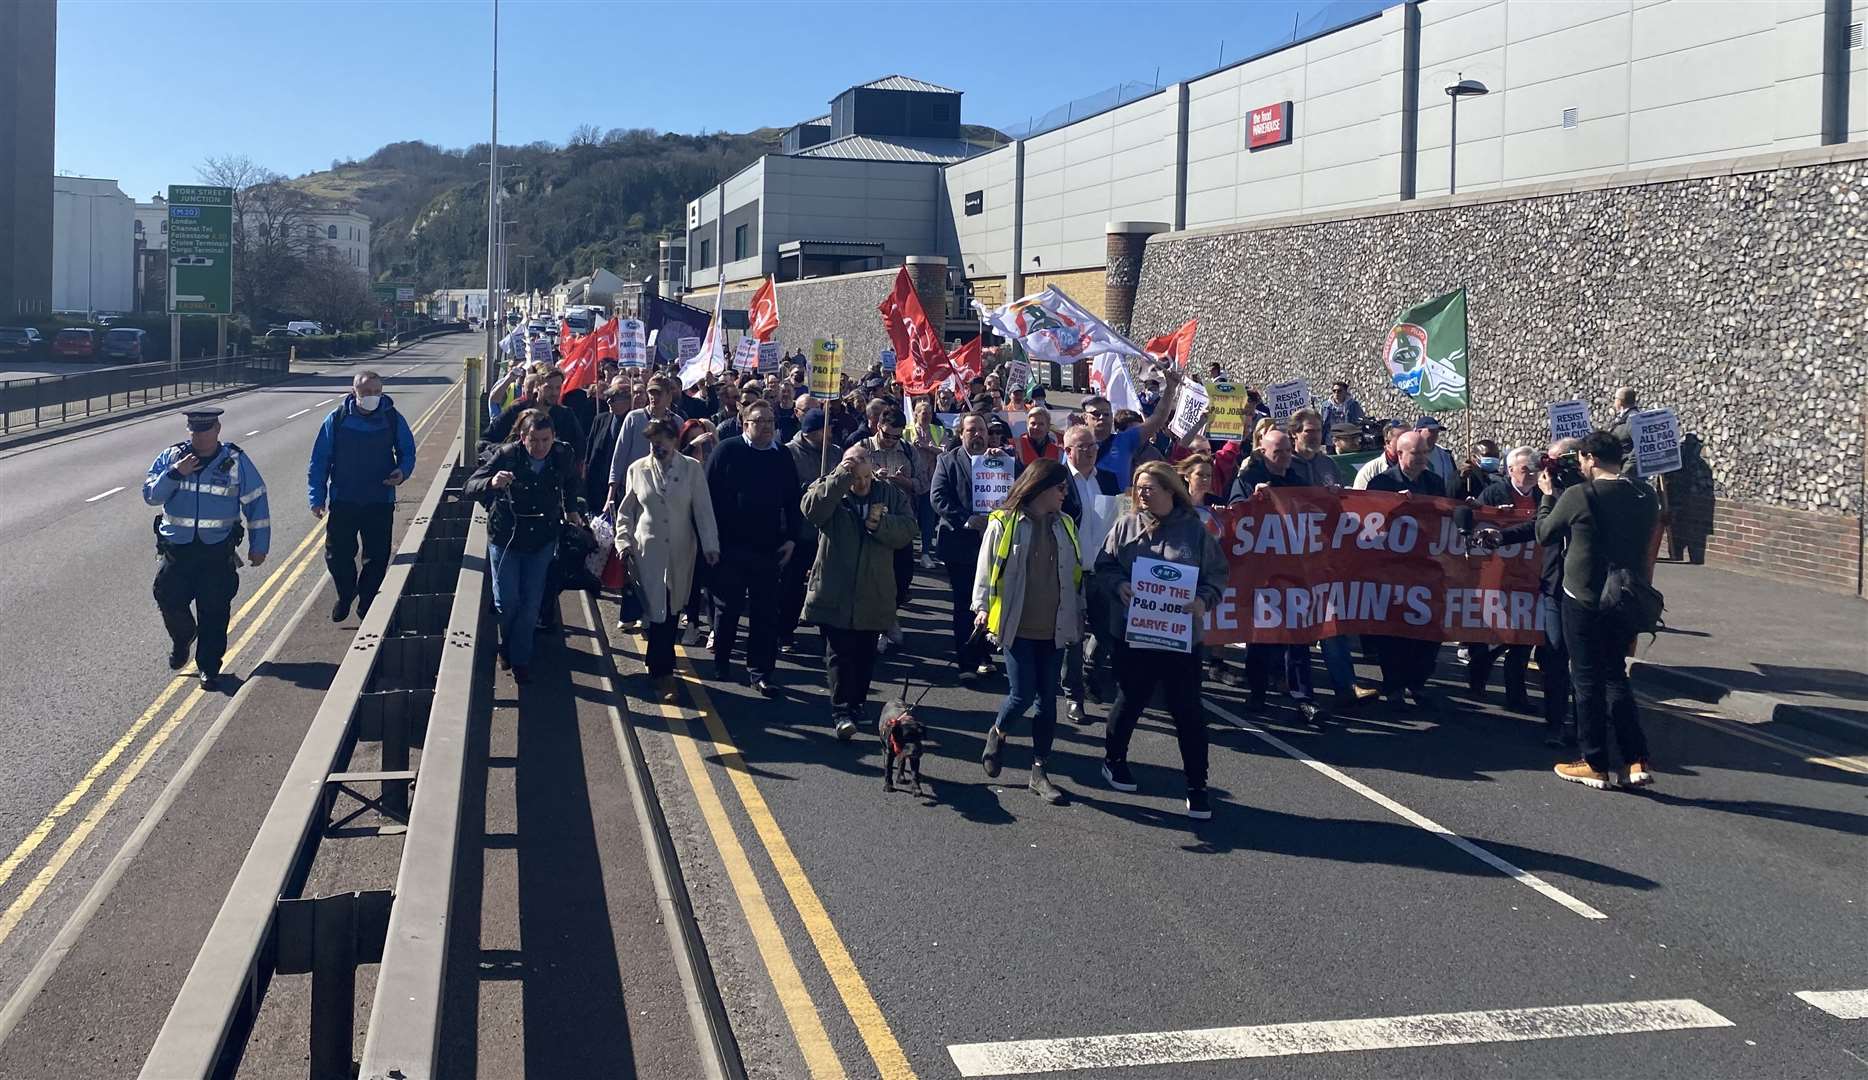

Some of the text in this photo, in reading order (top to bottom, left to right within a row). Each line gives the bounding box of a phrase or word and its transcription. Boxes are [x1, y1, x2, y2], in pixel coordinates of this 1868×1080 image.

[1261, 109, 1272, 121] food
[1253, 118, 1280, 136] WAREHOUSE
[1276, 390, 1301, 402] RESIST
[1275, 402, 1288, 411] ALL
[1556, 412, 1585, 423] RESIST
[1556, 421, 1588, 432] ALL P&O
[1641, 421, 1670, 434] RESIST
[1640, 430, 1674, 443] ALL P&O
[1639, 439, 1677, 454] JOB CUTS
[975, 471, 1011, 481] STOP THE
[974, 484, 991, 493] P&O
[1232, 512, 1327, 556] SAVE
[1332, 511, 1419, 553] P&O
[1136, 580, 1191, 600] STOP THE
[1132, 597, 1157, 611] P&O
[1254, 580, 1433, 629] BRITAIN'S
[1130, 617, 1187, 635] CARVE UP
